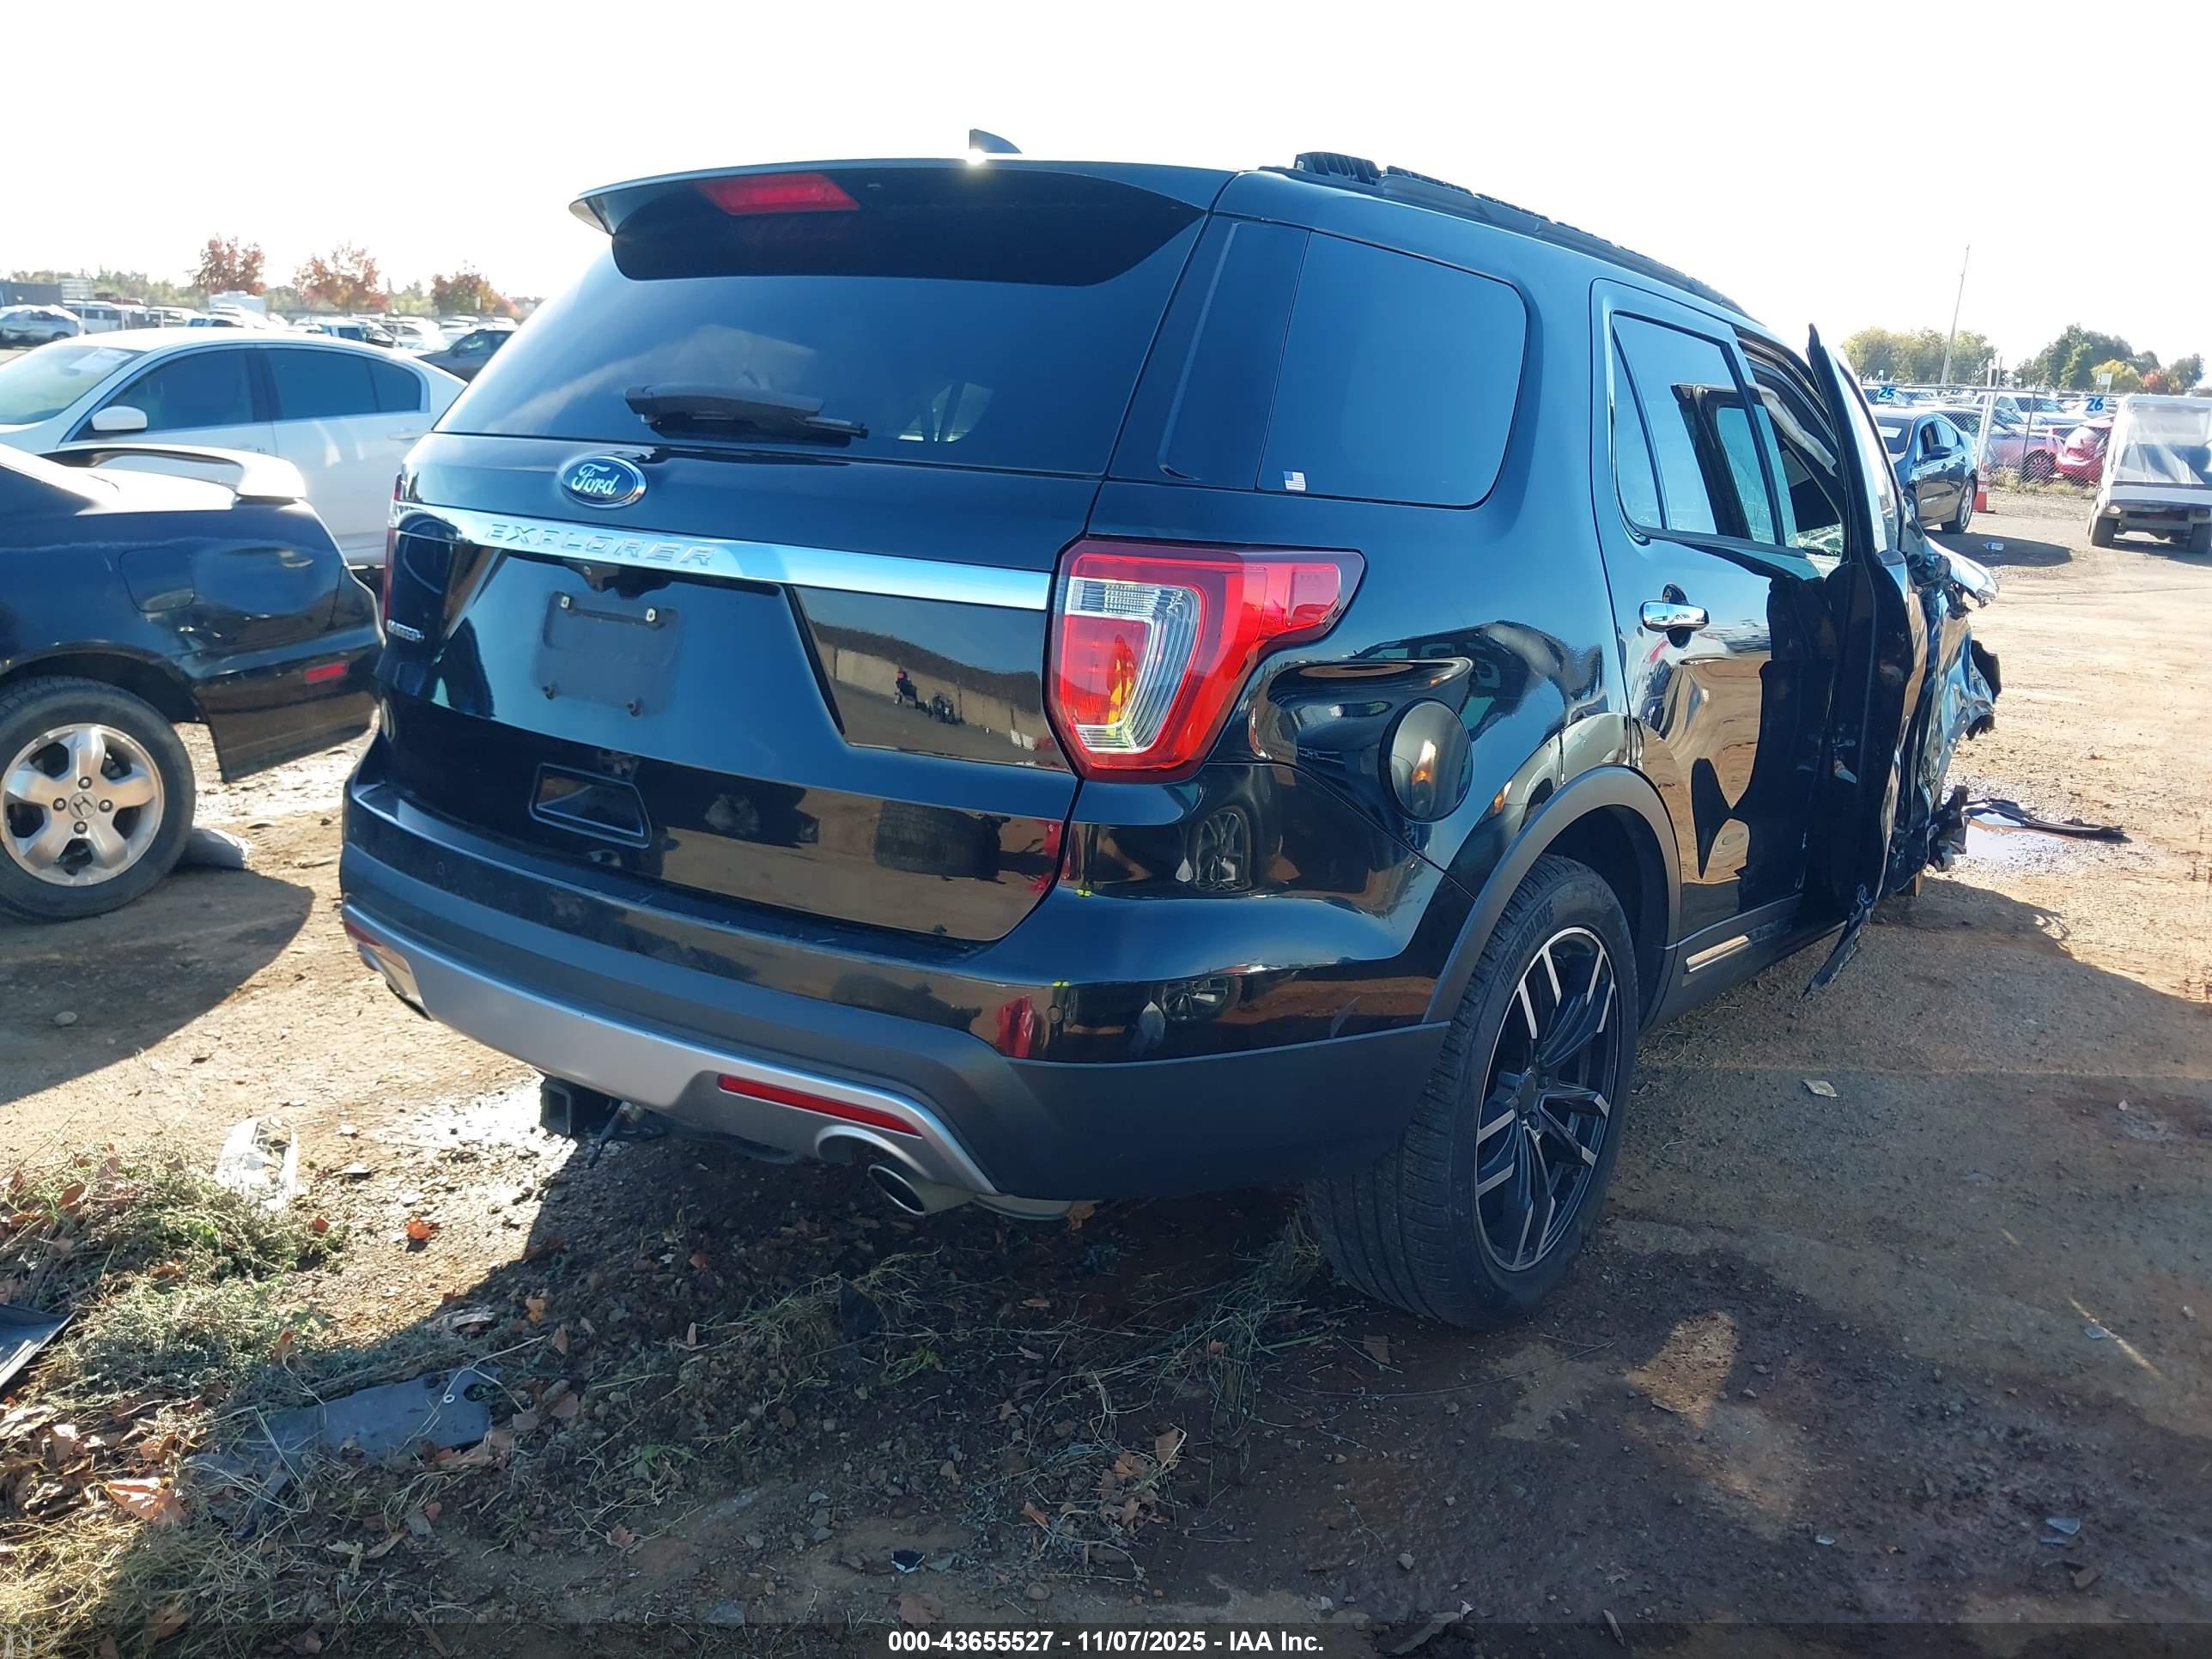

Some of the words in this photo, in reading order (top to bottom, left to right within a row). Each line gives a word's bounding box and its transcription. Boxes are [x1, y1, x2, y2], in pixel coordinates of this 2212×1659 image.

[1878, 386, 1897, 399] 25
[2085, 398, 2104, 411] 26
[570, 463, 620, 495] Ford
[484, 523, 716, 566] EXPLORER
